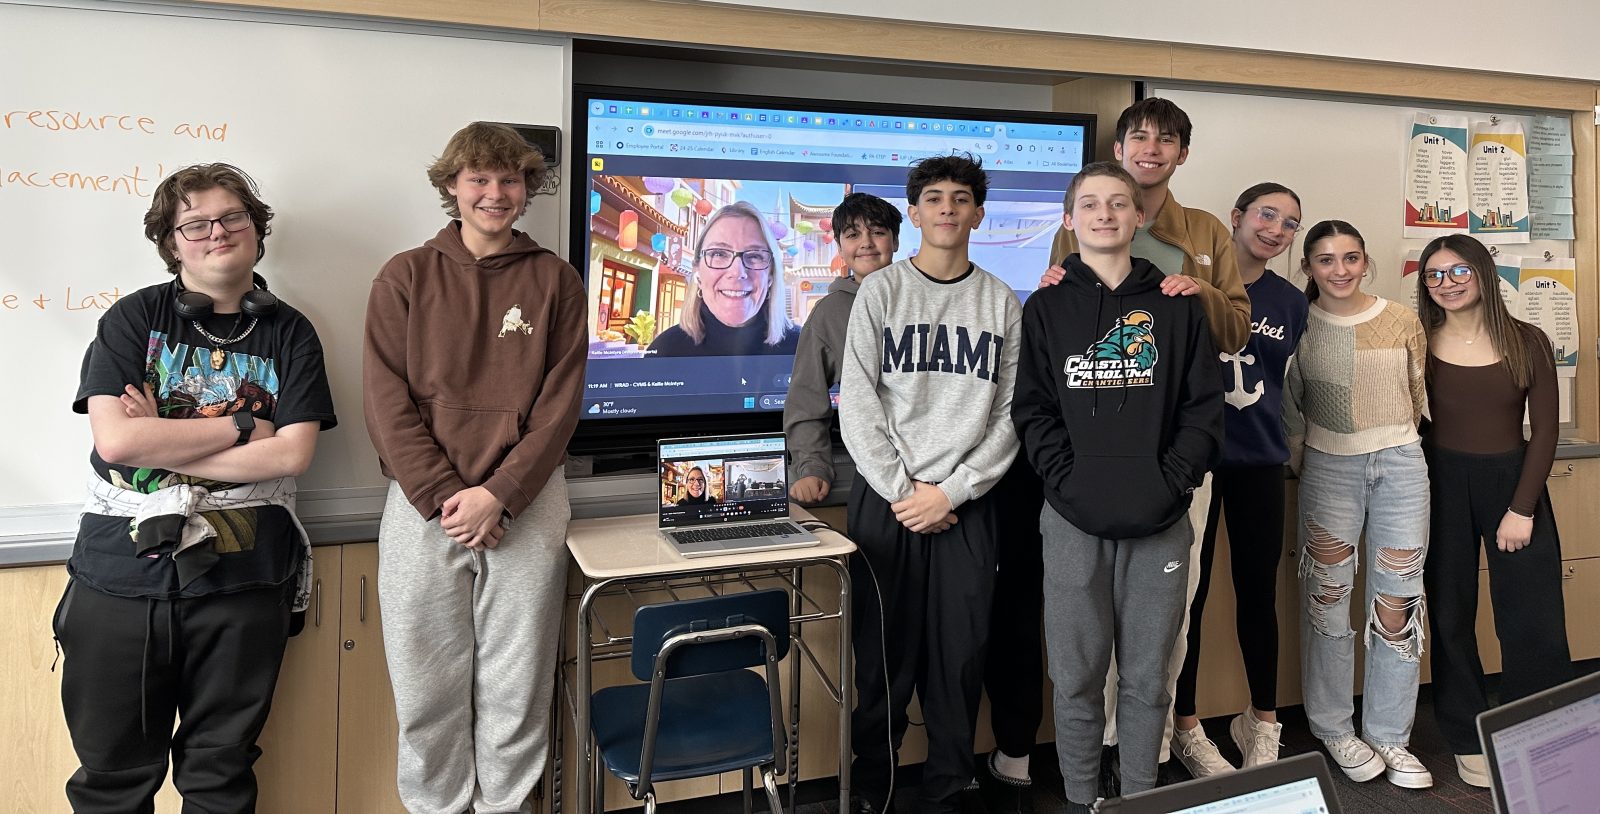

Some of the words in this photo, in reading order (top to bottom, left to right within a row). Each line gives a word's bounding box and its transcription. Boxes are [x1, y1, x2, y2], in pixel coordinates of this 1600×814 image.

[4, 109, 155, 134] resource
[174, 122, 228, 142] and
[1424, 136, 1440, 145] Unit
[1483, 146, 1498, 154] Unit
[1536, 280, 1550, 288] Unit
[1552, 280, 1557, 288] 5
[66, 286, 124, 311] Last
[882, 323, 1005, 385] MIAMI
[1066, 356, 1139, 372] COASTAL
[1069, 368, 1152, 386] CAROLINA
